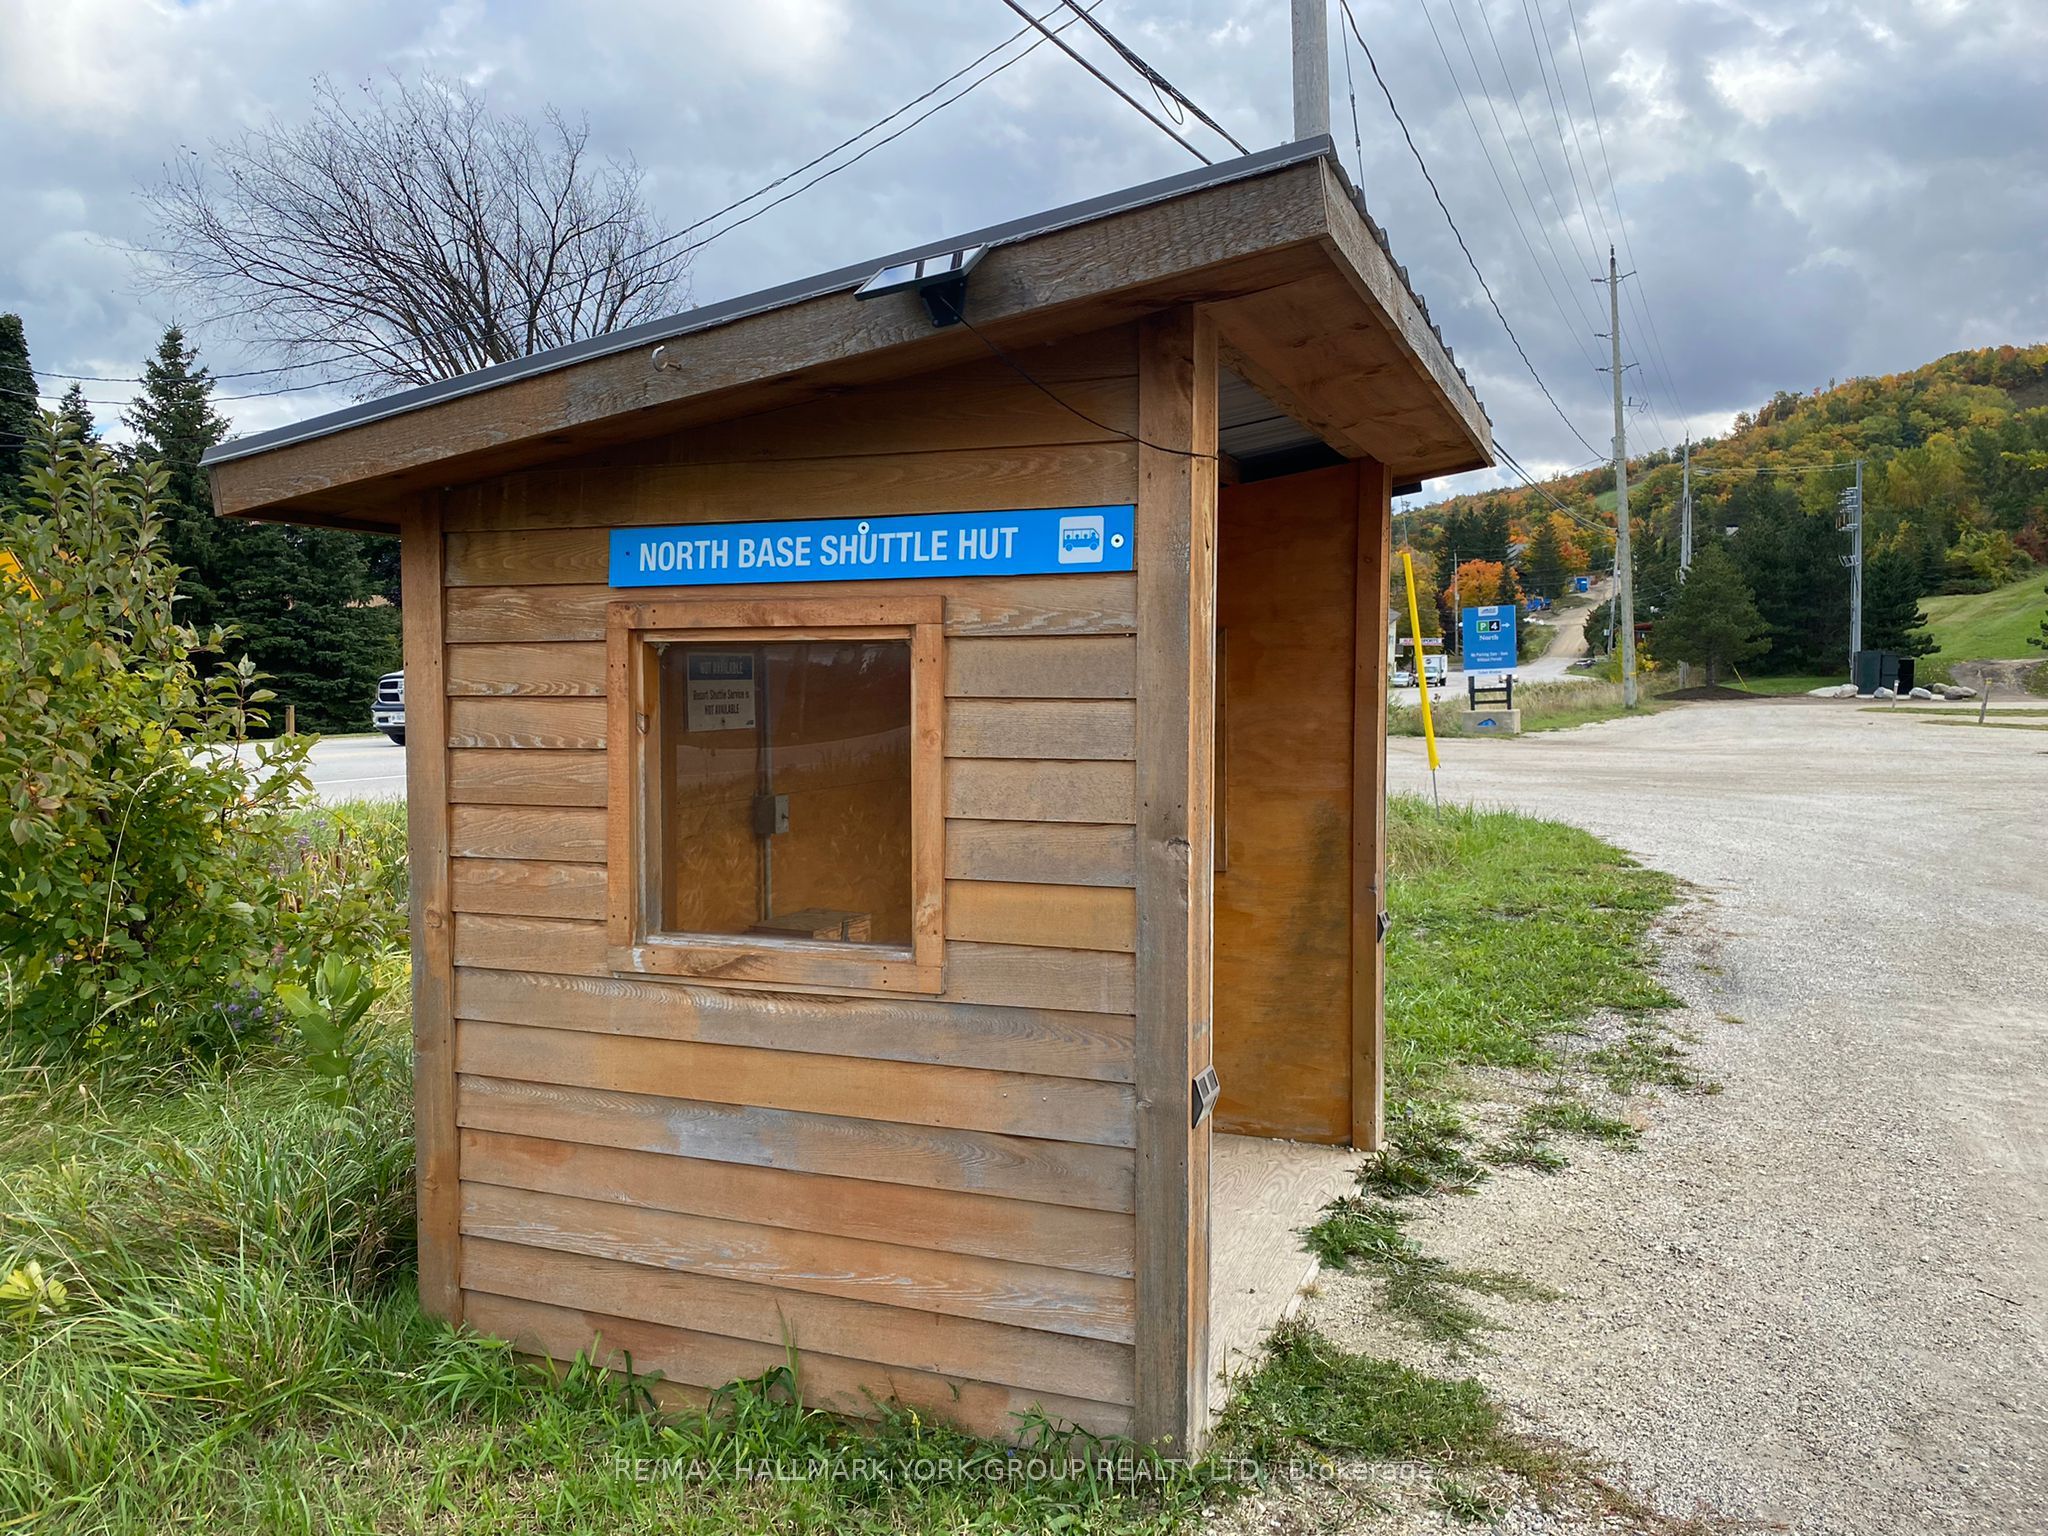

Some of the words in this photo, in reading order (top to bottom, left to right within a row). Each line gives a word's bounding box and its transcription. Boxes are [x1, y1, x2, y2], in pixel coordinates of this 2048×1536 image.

[639, 539, 729, 572] NORTH
[738, 536, 812, 569] BASE
[819, 530, 948, 566] SHUTTLE
[958, 526, 1019, 561] HUT
[1480, 622, 1487, 631] P
[1490, 622, 1498, 630] 4
[715, 704, 739, 715] AVAILABLE
